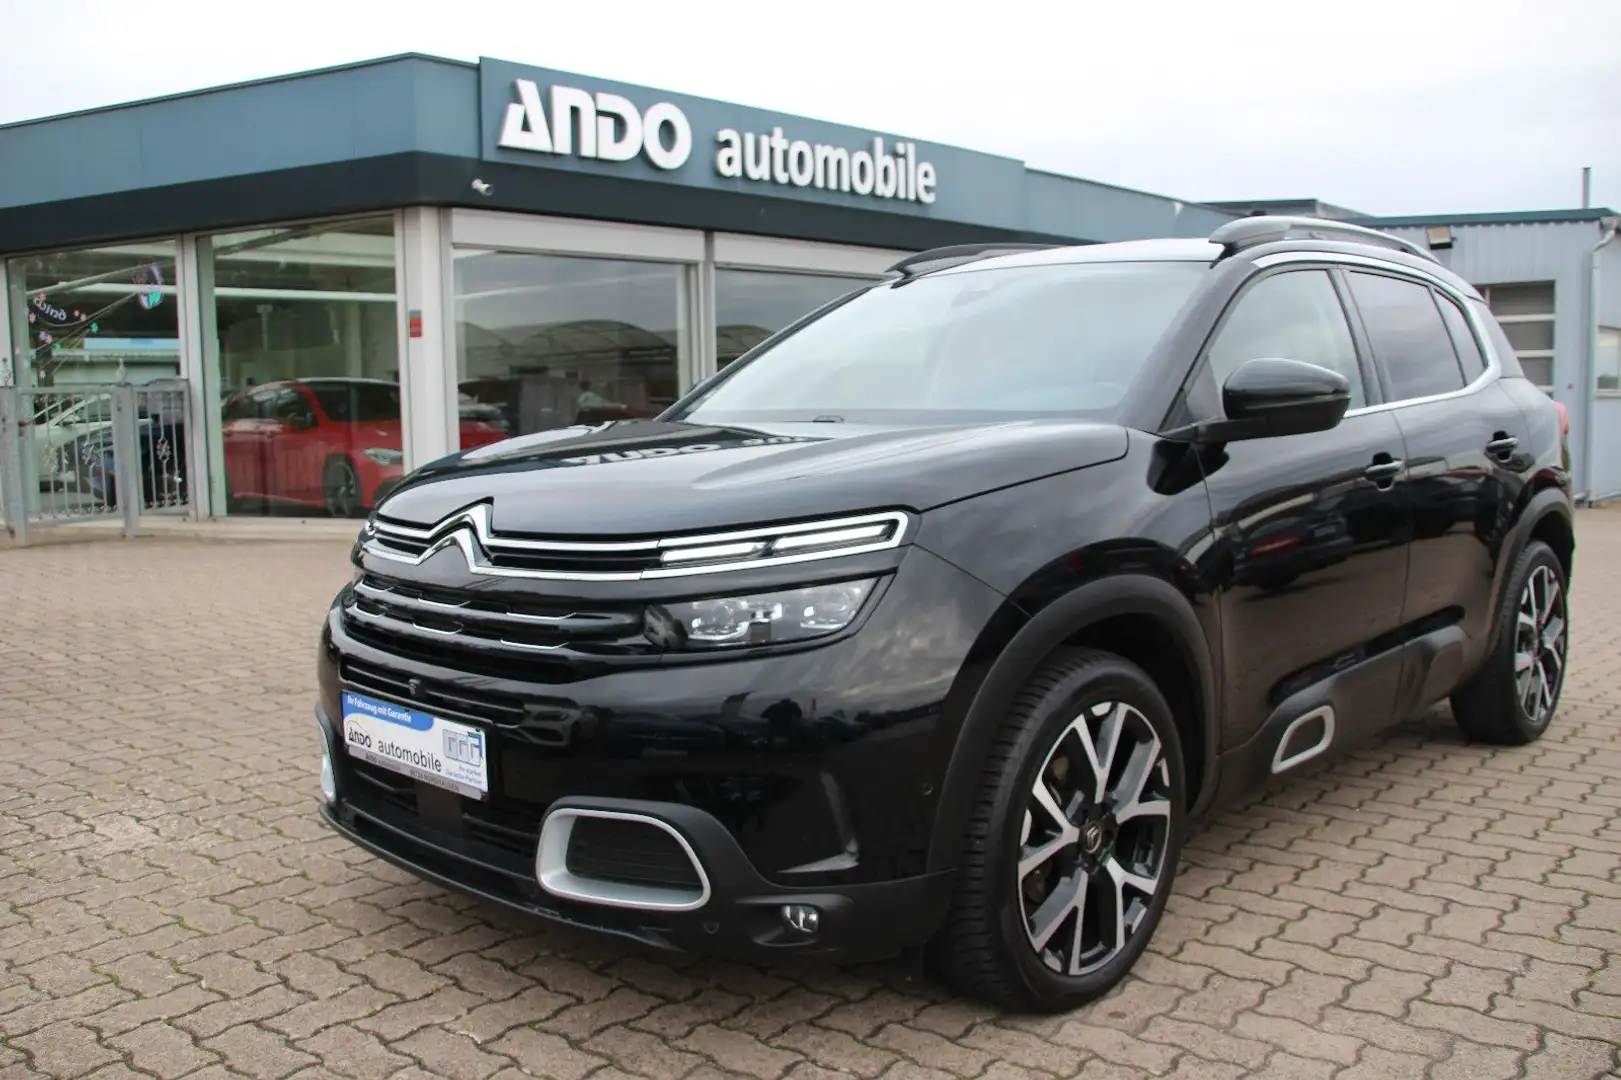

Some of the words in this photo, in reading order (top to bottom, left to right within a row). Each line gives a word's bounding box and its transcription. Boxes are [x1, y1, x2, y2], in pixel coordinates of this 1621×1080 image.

[498, 79, 692, 170] ANDO
[716, 127, 936, 204] automobile
[387, 708, 412, 722] Garantie
[349, 727, 372, 748] ANDO
[378, 739, 442, 773] automobile
